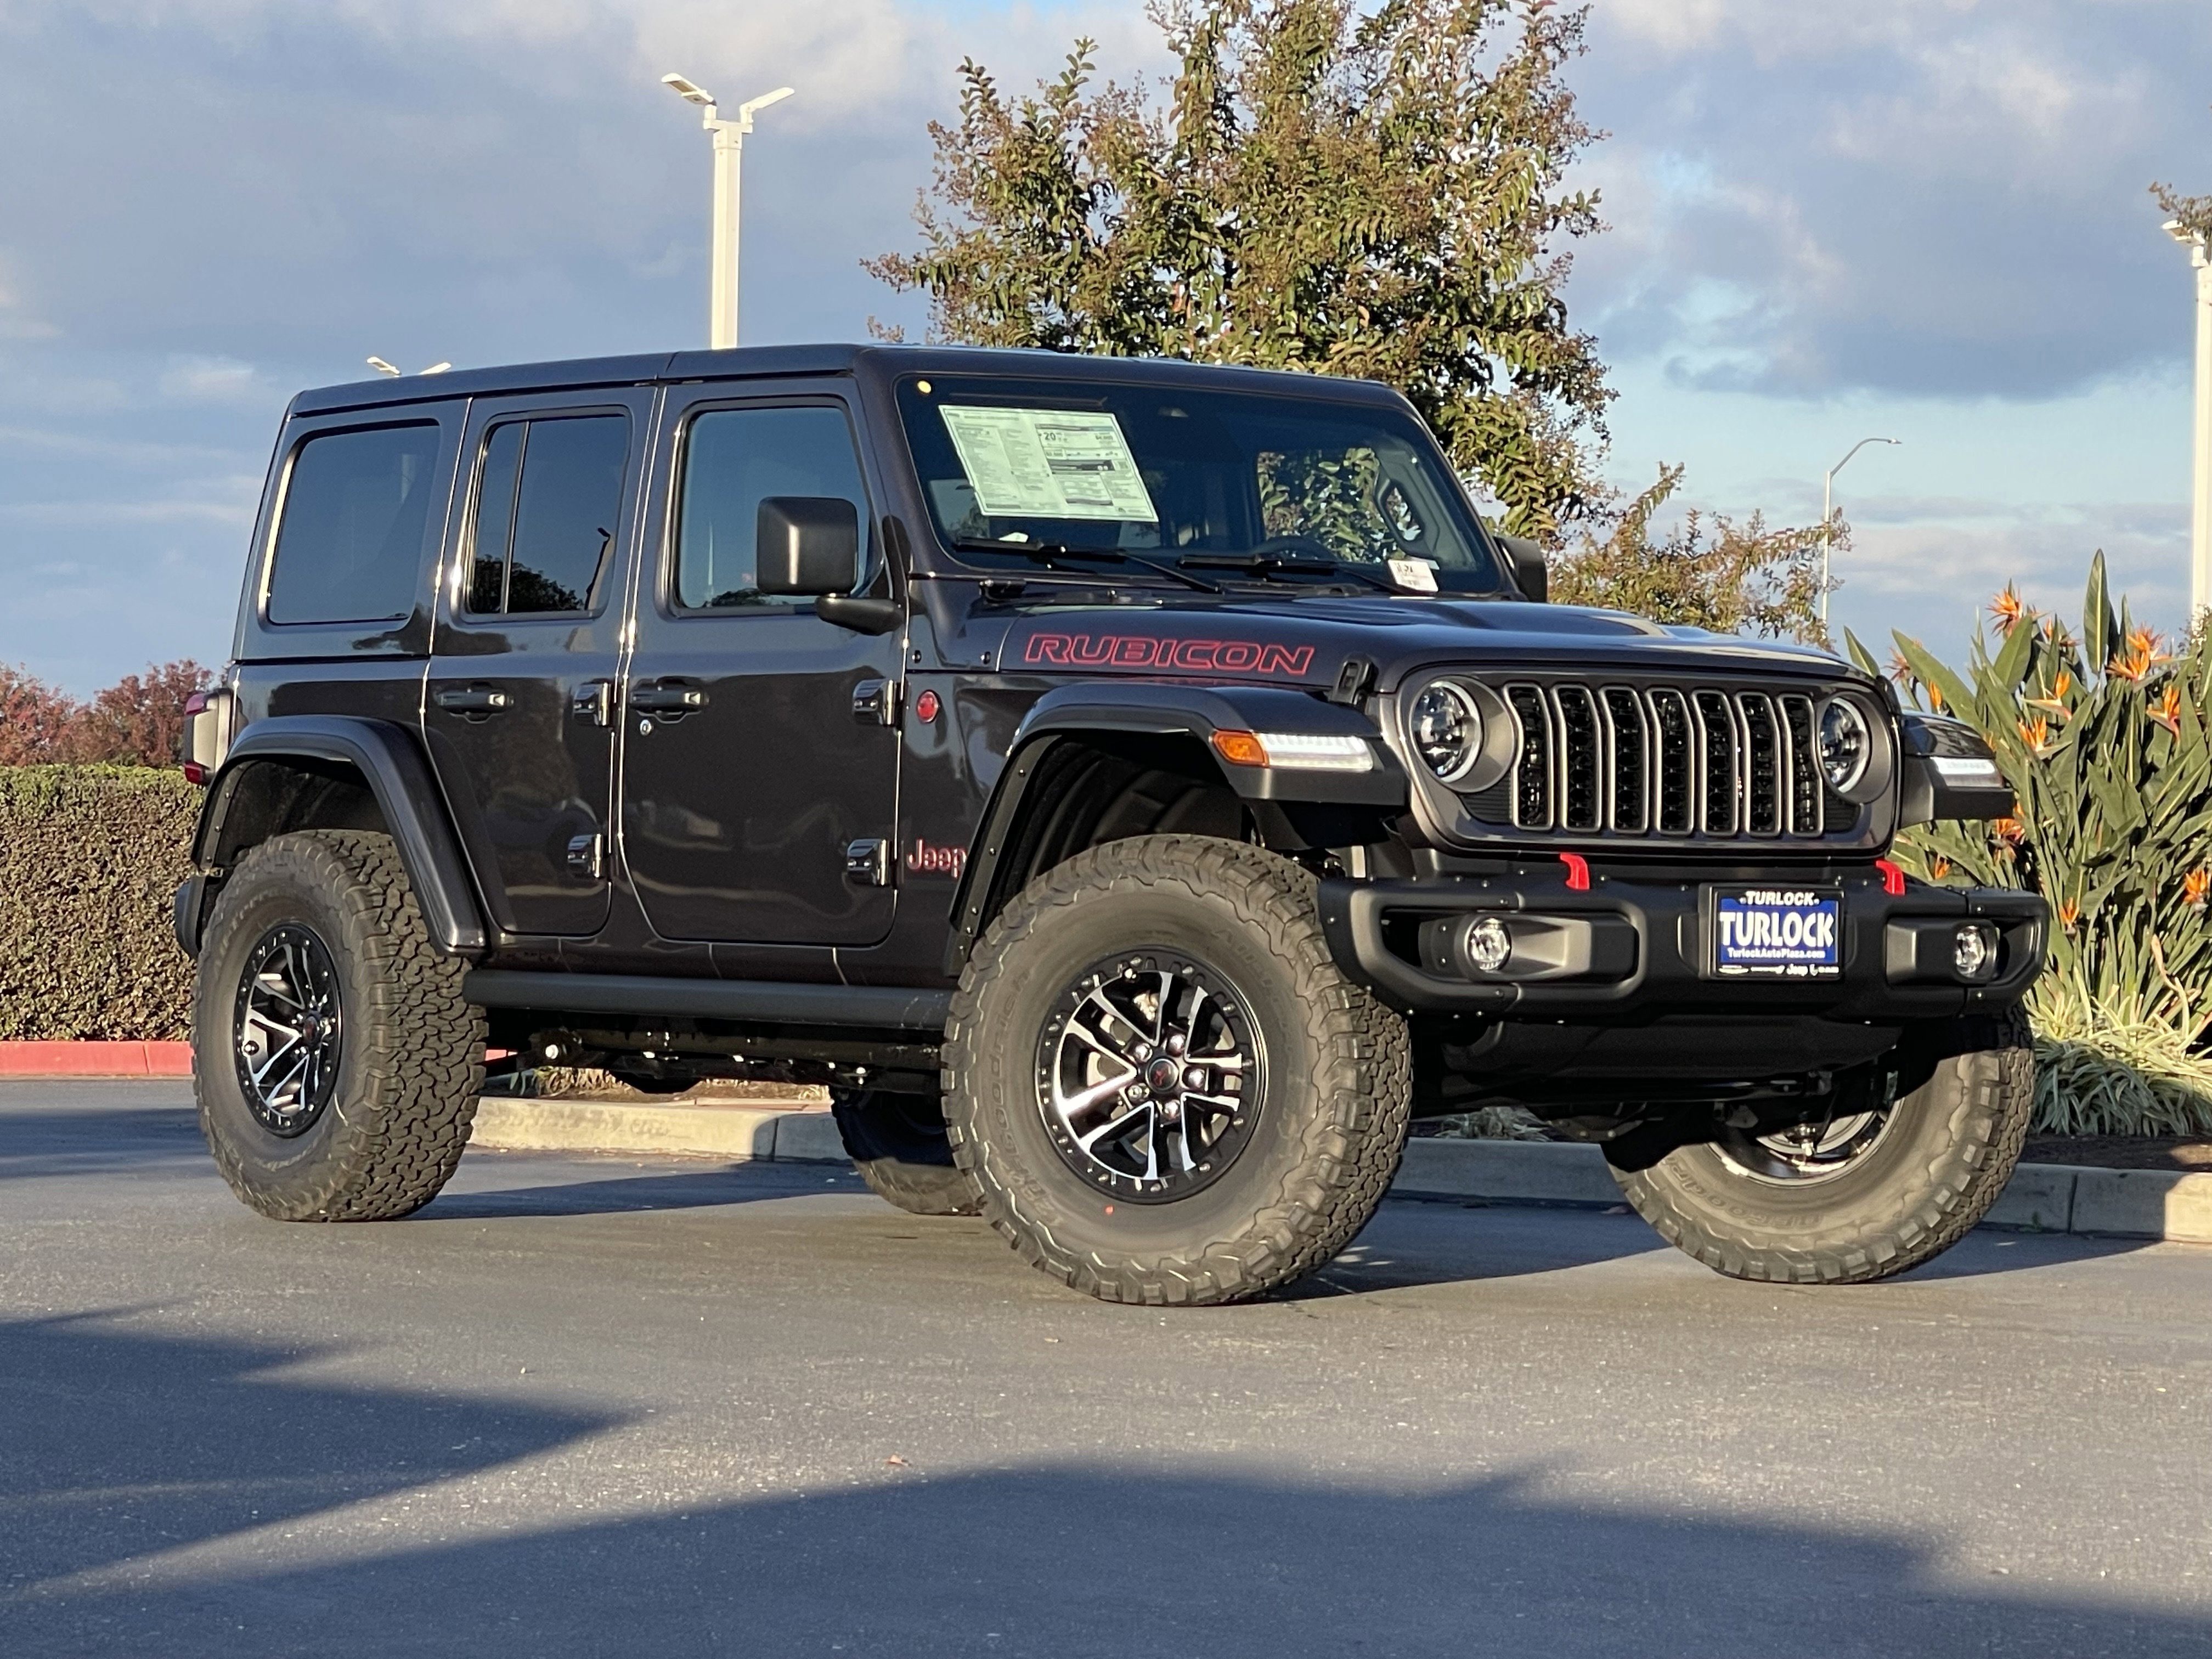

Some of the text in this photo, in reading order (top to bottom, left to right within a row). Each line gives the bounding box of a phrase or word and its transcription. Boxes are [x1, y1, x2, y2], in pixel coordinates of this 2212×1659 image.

[1025, 634, 1314, 675] RUBICON
[906, 839, 967, 879] Jeep
[1745, 891, 1815, 906] TURLOCK
[1719, 912, 1833, 947] TURLOCK
[1728, 948, 1826, 959] TurlockAutoPlaza.com
